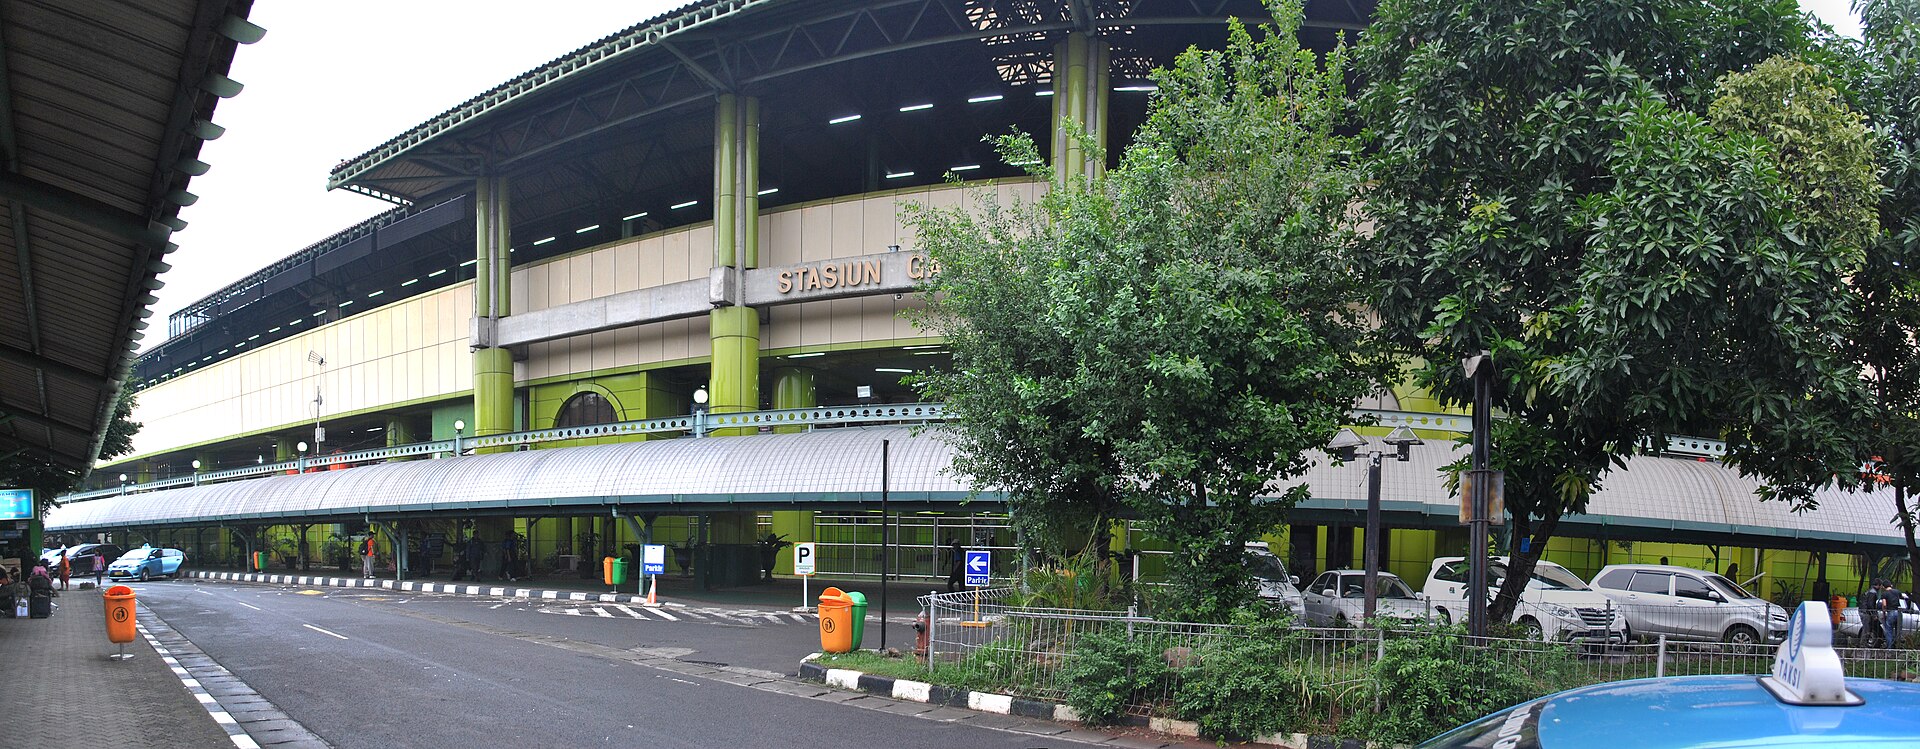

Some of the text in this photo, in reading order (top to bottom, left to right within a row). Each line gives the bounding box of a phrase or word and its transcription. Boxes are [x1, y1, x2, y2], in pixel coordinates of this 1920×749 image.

[778, 258, 881, 294] STASIUN
[798, 546, 810, 563] P
[645, 564, 663, 572] Parkir
[967, 576, 988, 584] Parkir
[1779, 658, 1802, 690] TAKSI
